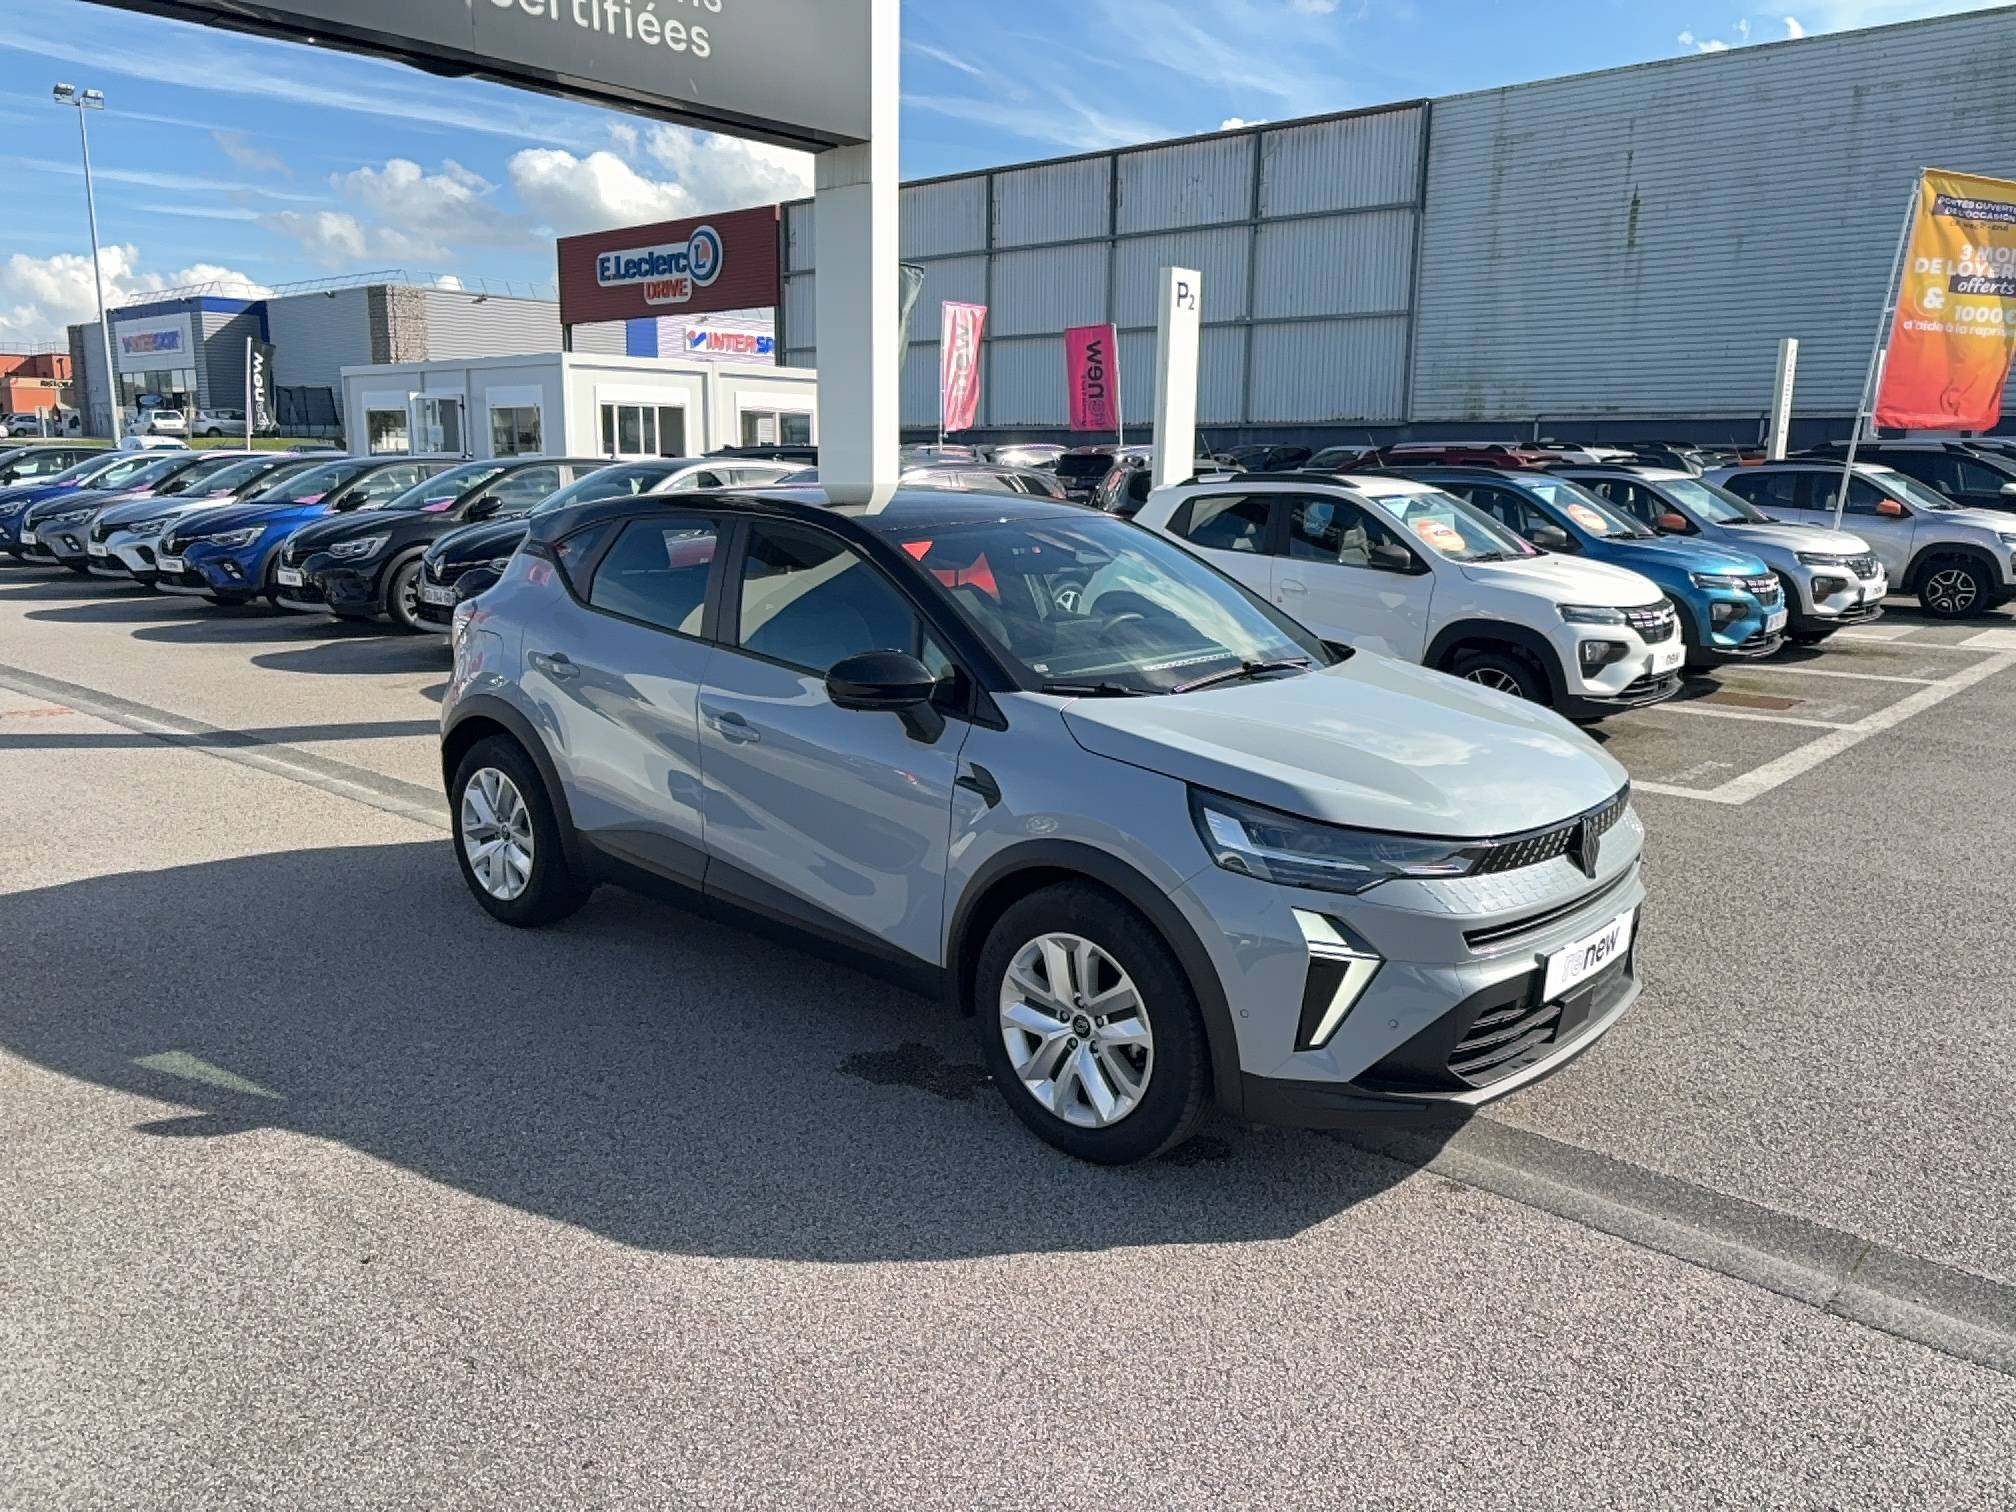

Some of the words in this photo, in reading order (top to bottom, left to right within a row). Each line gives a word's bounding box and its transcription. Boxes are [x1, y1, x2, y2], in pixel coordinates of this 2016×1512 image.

[490, 0, 711, 57] rtifiées
[1960, 244, 1973, 261] 3
[599, 251, 688, 281] E.Leclerc
[1914, 257, 1943, 275] DE
[1947, 259, 2016, 279] LOYER
[646, 277, 688, 300] DRIVE
[1957, 277, 2015, 295] offerts
[1923, 287, 1945, 309] &
[1903, 320, 1944, 332] d'aide
[1956, 325, 1968, 334] la
[1969, 326, 2016, 338] repri
[1562, 925, 1621, 983] renew
